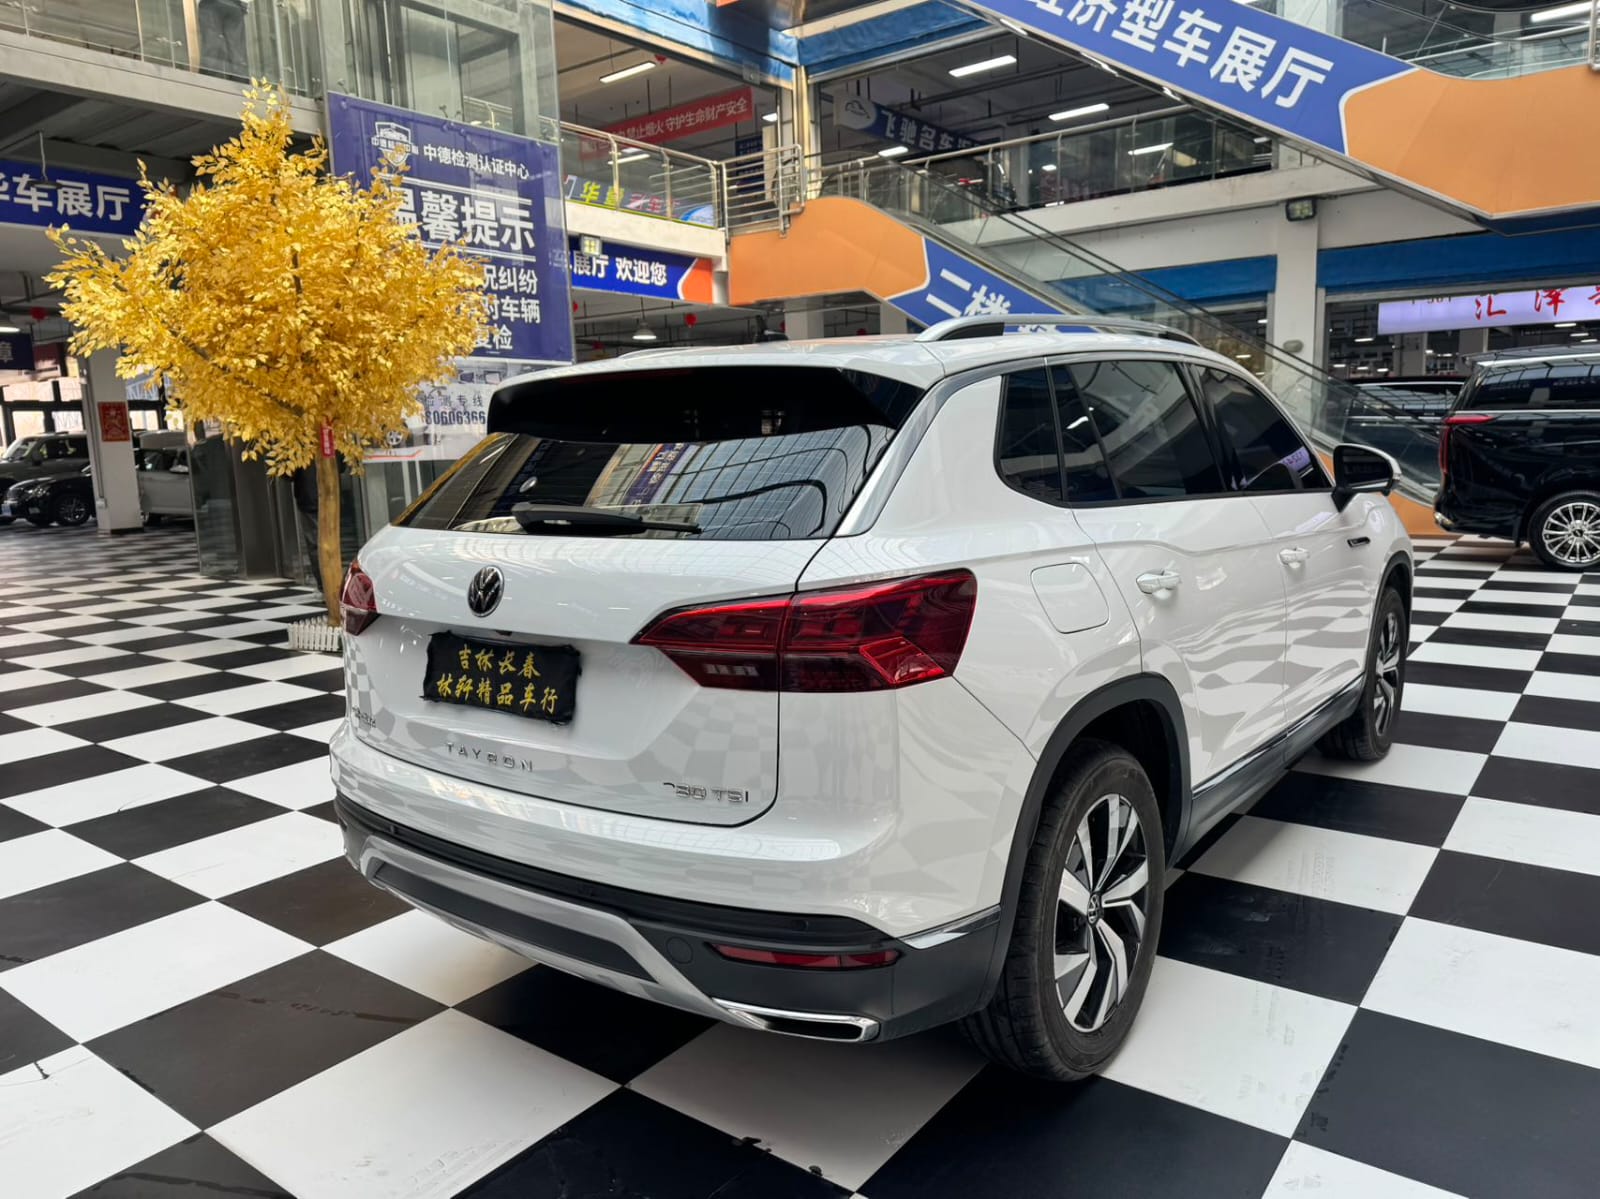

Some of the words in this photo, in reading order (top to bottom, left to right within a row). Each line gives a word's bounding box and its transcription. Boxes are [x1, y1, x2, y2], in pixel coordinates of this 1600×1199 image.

[665, 97, 748, 132] 守护生命财产安全
[423, 143, 530, 180] 中德检测认证中心
[615, 257, 667, 286] 欢迎您
[458, 643, 541, 680] 吉林长春
[436, 672, 559, 714] 林轩精品车行
[445, 742, 533, 772] TAYRON
[711, 788, 749, 804] TSI
